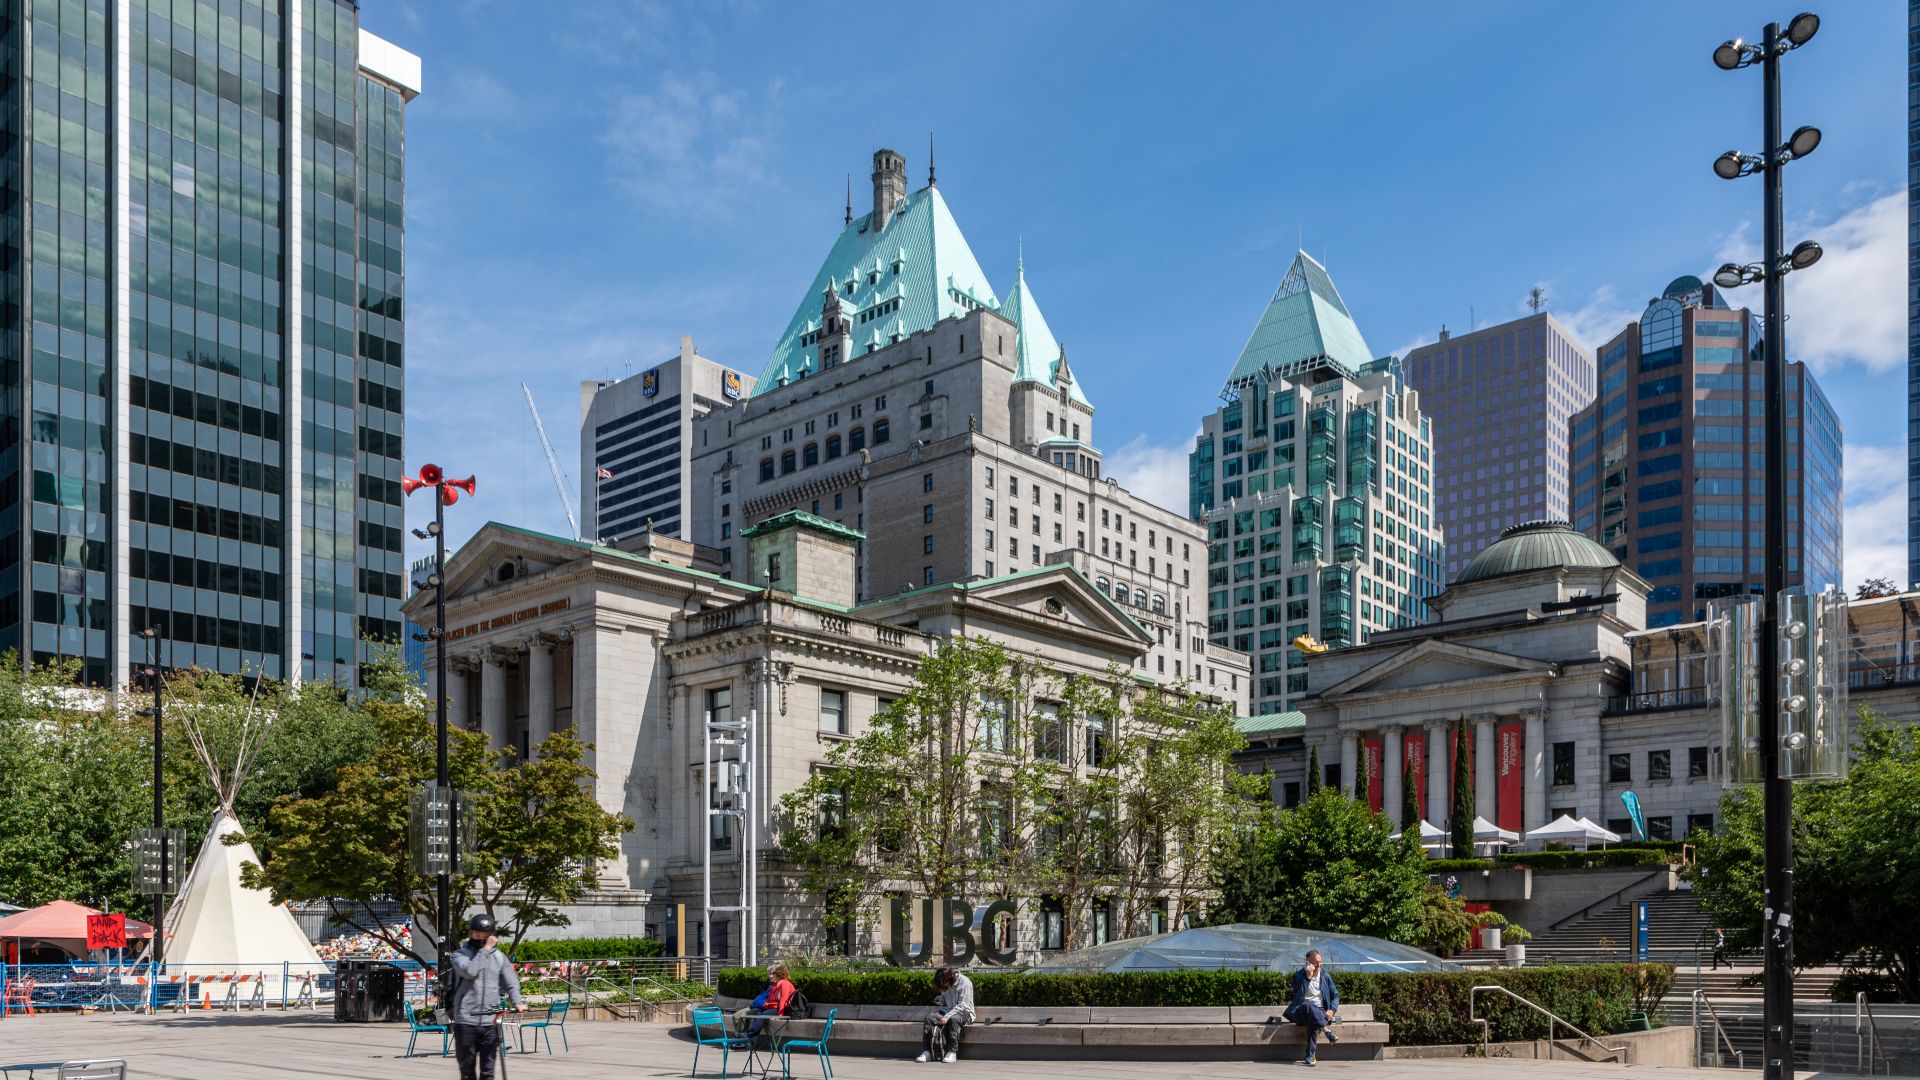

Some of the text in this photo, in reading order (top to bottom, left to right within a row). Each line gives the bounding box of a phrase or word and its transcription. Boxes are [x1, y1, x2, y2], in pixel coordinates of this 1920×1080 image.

[727, 387, 740, 397] RBC
[480, 620, 489, 631] THE
[90, 917, 118, 928] LAND
[881, 898, 1017, 967] UBC
